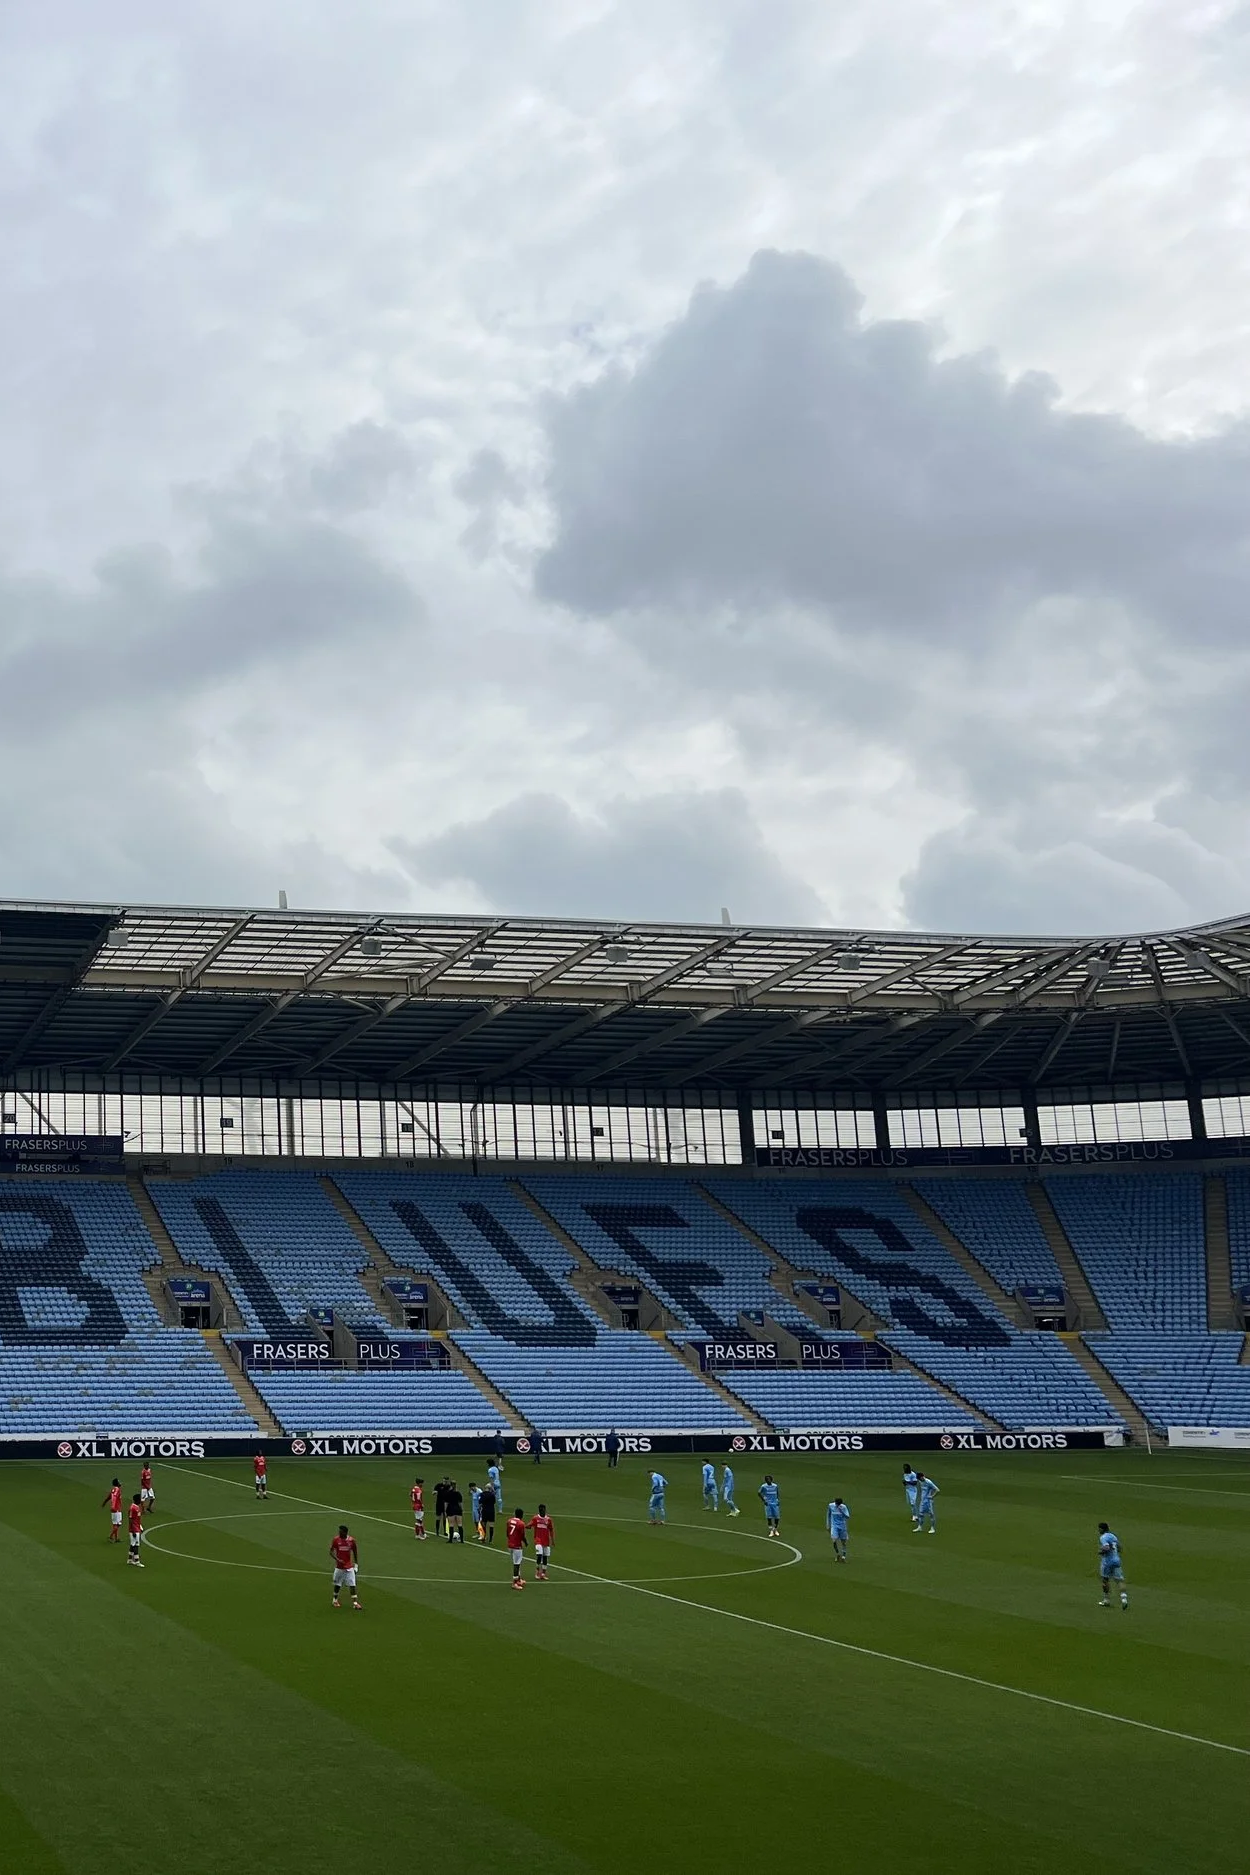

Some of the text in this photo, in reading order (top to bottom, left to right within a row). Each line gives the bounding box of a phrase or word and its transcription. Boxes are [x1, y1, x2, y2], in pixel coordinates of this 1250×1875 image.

[3, 1114, 15, 1122] 20
[221, 1118, 232, 1126] 19
[5, 1139, 87, 1151] FRASERSPLUS
[769, 1150, 908, 1166] FRASERSPLUS
[1009, 1142, 1174, 1163] FRASERSPLUS
[16, 1164, 79, 1172] FRASERSPLUS
[254, 1344, 400, 1359] FRASERS PLUS
[706, 1344, 840, 1359] FRASERS PLUS
[310, 1439, 432, 1454] XL MOTORS
[749, 1436, 863, 1450] XL MOTORS
[956, 1435, 1067, 1448] XL MOTORS
[77, 1441, 204, 1457] XL MOTORS
[509, 1524, 515, 1535] 7
